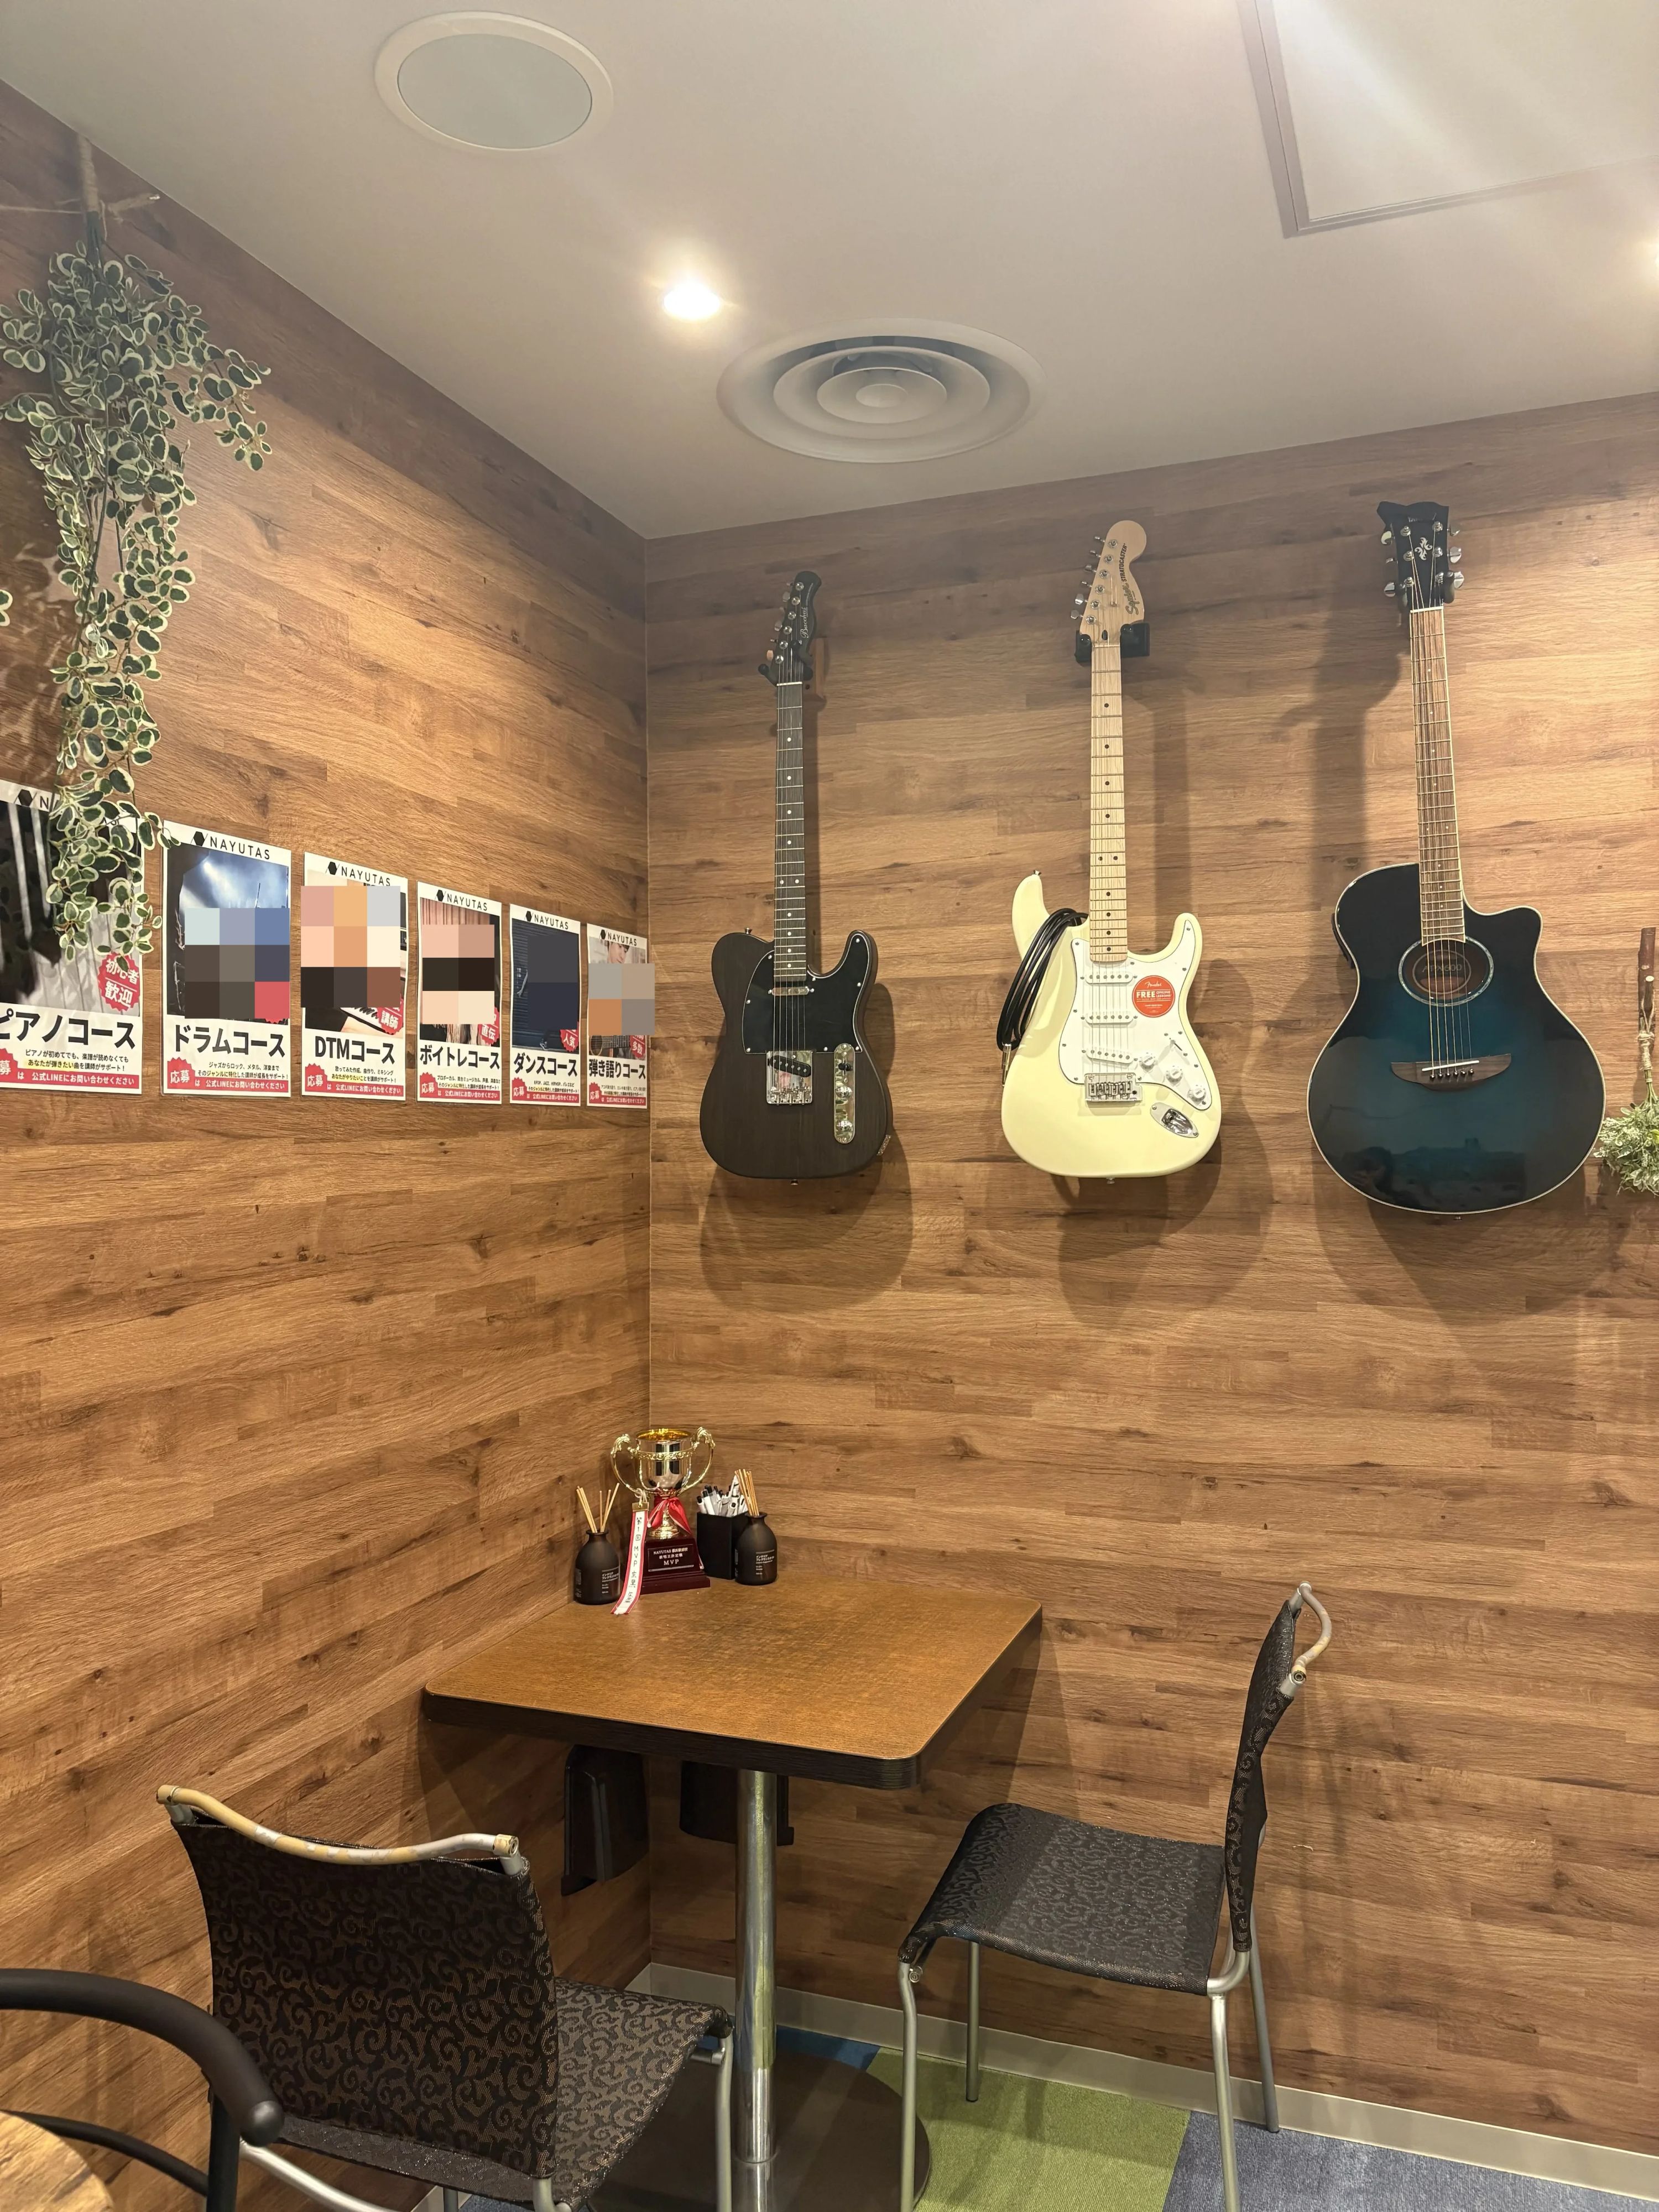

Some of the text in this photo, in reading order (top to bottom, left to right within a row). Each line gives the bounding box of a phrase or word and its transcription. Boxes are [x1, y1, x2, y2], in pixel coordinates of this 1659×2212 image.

[1119, 543, 1128, 582] STRATOCASTER
[800, 607, 809, 638] Bacchus
[211, 836, 270, 860] NAYUTAS
[341, 866, 390, 886] NAYUTAS
[447, 893, 488, 911] NAYUTAS
[534, 914, 569, 930] NAYUTAS
[608, 932, 637, 946] NAYUTAS
[1144, 980, 1162, 989] Fender
[105, 981, 133, 1008] 歓迎
[380, 1010, 399, 1030] 講師
[0, 1008, 135, 1050] ピアノコース
[481, 1024, 496, 1041] 直伝
[175, 1025, 285, 1057] ドラムコース
[563, 1033, 576, 1048] 人気
[25, 1048, 129, 1063] ピアノが初めてでも、楽譜が読めなくても
[315, 1036, 395, 1065] DTMコース
[420, 1045, 500, 1070] ボイトレコース
[28, 1059, 125, 1071] あなたが弾きたい曲を講師がサポート！
[208, 1061, 280, 1071] ジャズからロック、メタル、洋楽まで
[514, 1052, 578, 1077] ダンスコース
[589, 1058, 646, 1079] 弾き語りコース
[32, 1072, 134, 1086] 公式LINEにお問い合わせください
[170, 1070, 190, 1084] 応募
[206, 1080, 285, 1089] 公式LINEにお問い合わせください
[307, 1074, 324, 1087] 応募
[336, 1084, 401, 1094] 公式LINEにお問い合わせください
[421, 1082, 435, 1094] 応募
[513, 1086, 525, 1097] 応募
